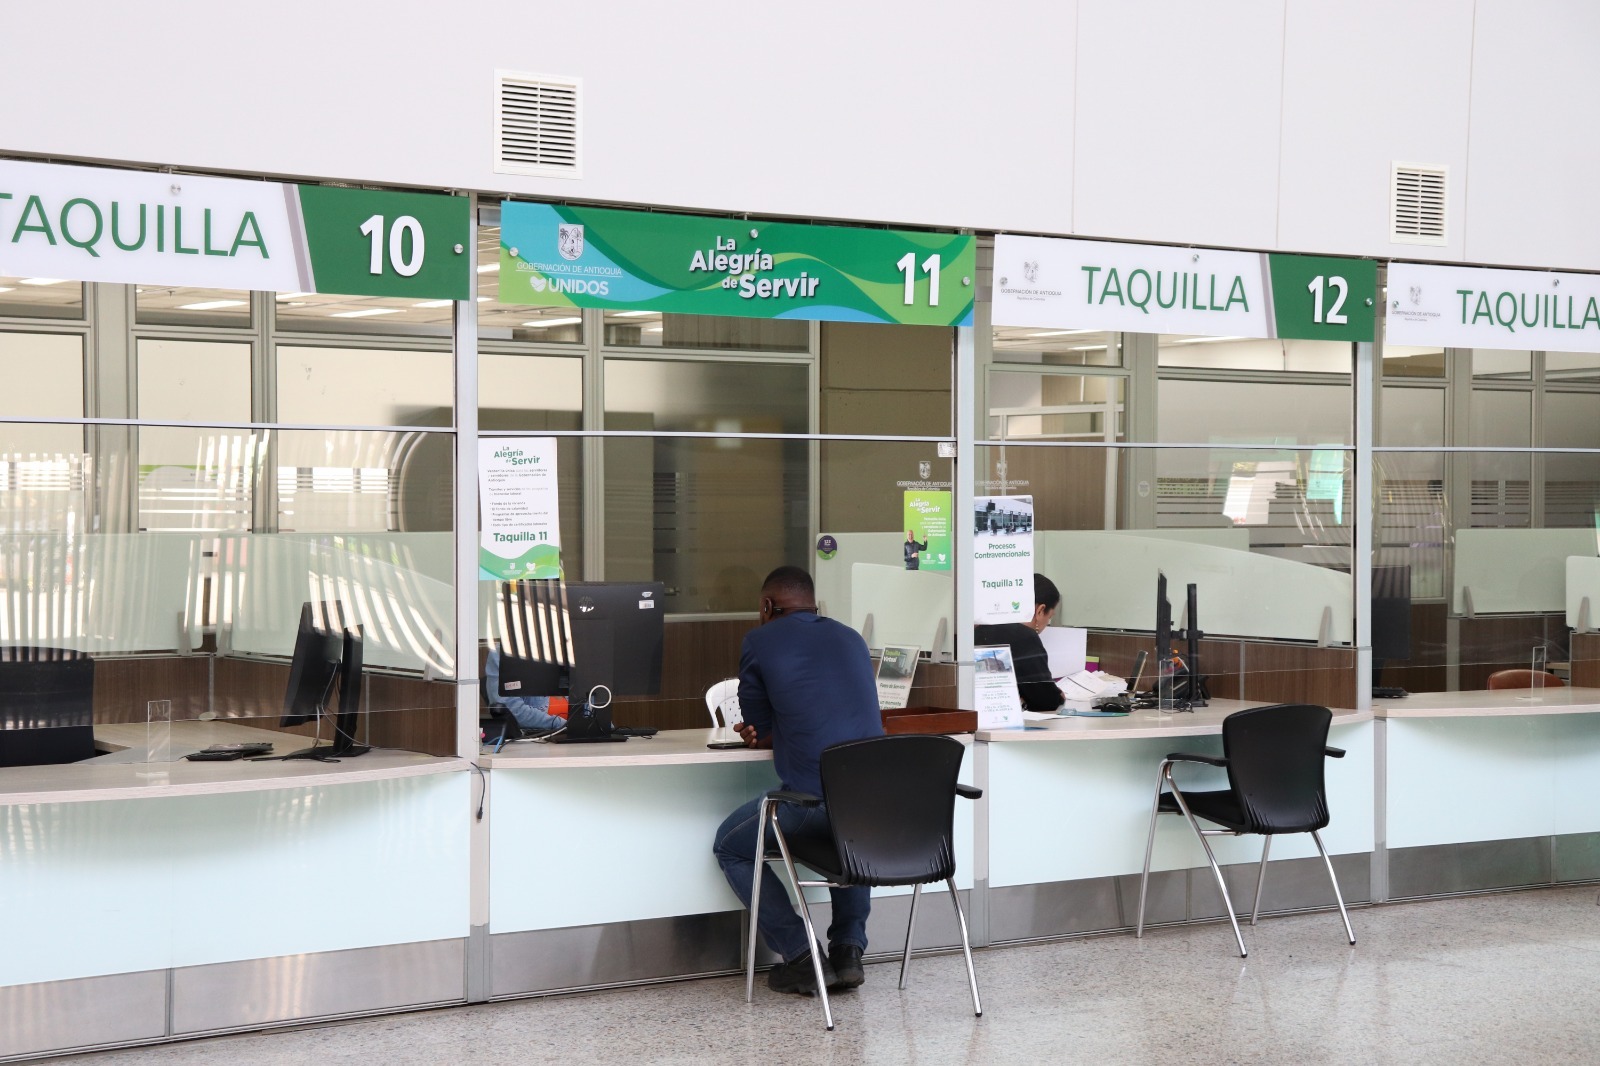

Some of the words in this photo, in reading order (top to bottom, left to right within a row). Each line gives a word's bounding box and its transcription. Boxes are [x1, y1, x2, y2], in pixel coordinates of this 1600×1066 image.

[0, 192, 270, 259] AQUILLA
[359, 215, 426, 277] 10
[716, 236, 736, 251] La
[516, 262, 570, 272] GOBERNACIÓN
[572, 265, 582, 274] DE
[689, 248, 773, 275] Alegría
[548, 277, 609, 296] UNIDOS
[721, 277, 738, 289] de
[738, 272, 820, 299] Servir
[896, 252, 941, 306] 11
[1081, 265, 1250, 315] TAQUILLA
[1308, 275, 1349, 325] 12
[1456, 289, 1600, 333] TAQUILLA
[511, 456, 540, 465] Servir
[493, 531, 536, 543] Taquilla
[539, 531, 548, 541] 11
[974, 550, 1031, 559] Contravencionales
[981, 579, 1013, 589] Taquilla
[1014, 578, 1024, 587] 12
